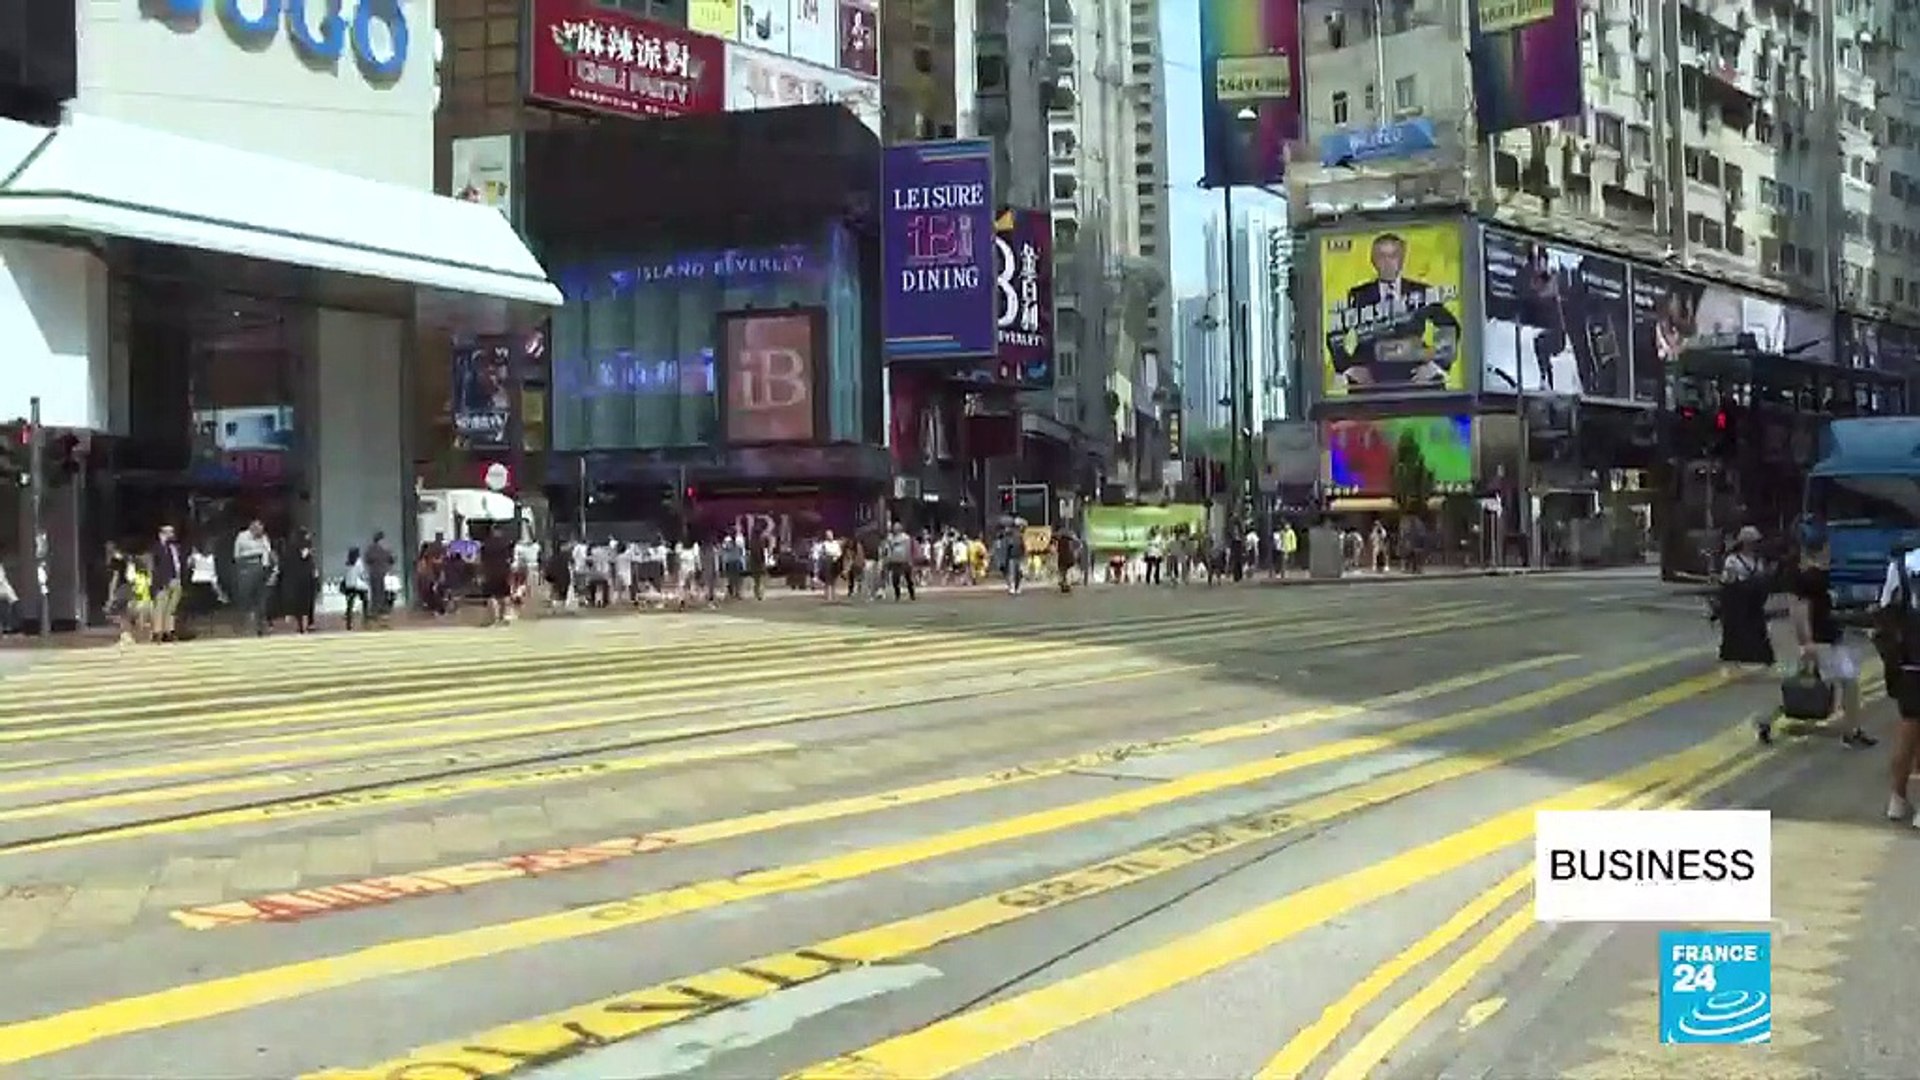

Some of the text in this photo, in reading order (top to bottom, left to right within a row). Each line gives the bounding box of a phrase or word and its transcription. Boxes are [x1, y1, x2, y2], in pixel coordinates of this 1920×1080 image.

[140, 0, 409, 88] OGO
[894, 183, 984, 210] LEISURE
[637, 254, 804, 281] ISLAND BEVERLEY
[902, 267, 979, 291] DINING
